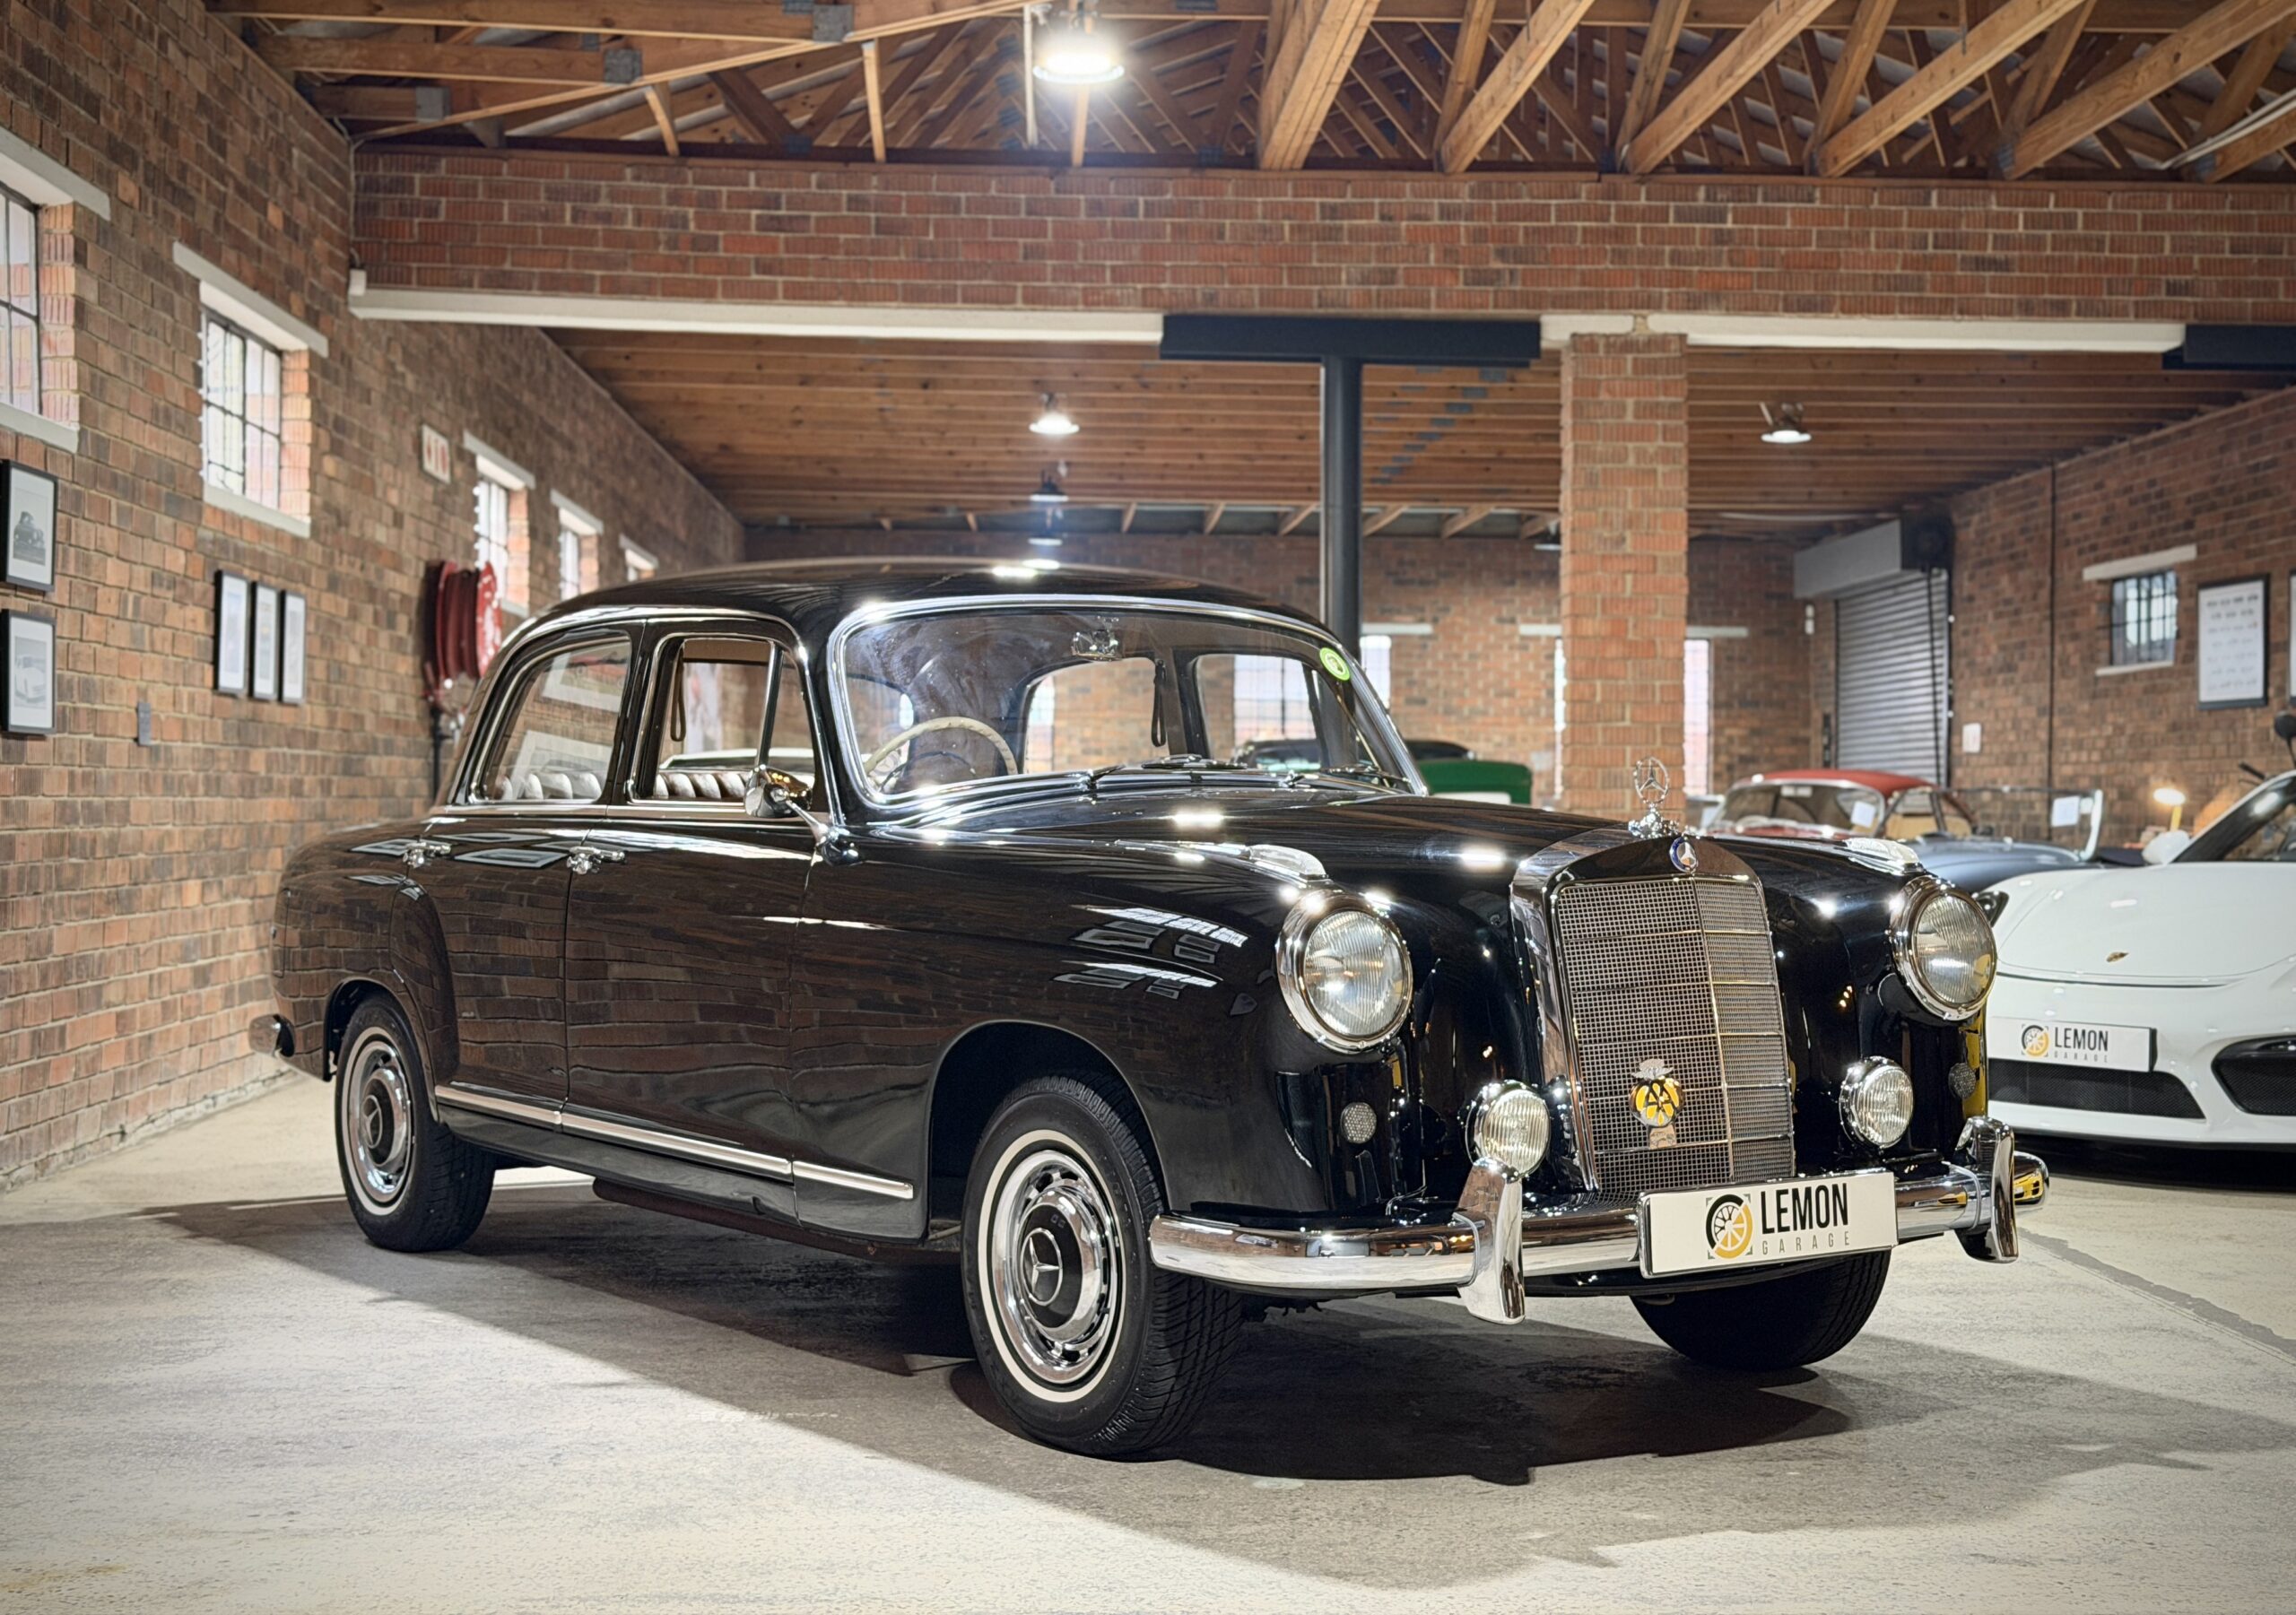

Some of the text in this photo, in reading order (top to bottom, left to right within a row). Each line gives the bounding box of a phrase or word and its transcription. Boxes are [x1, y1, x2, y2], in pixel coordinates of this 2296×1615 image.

[2055, 1027, 2109, 1052] LEMON
[2054, 1051, 2108, 1064] GARAGE
[1761, 1183, 1848, 1234] LEMON
[1761, 1231, 1849, 1255] GARAGE
